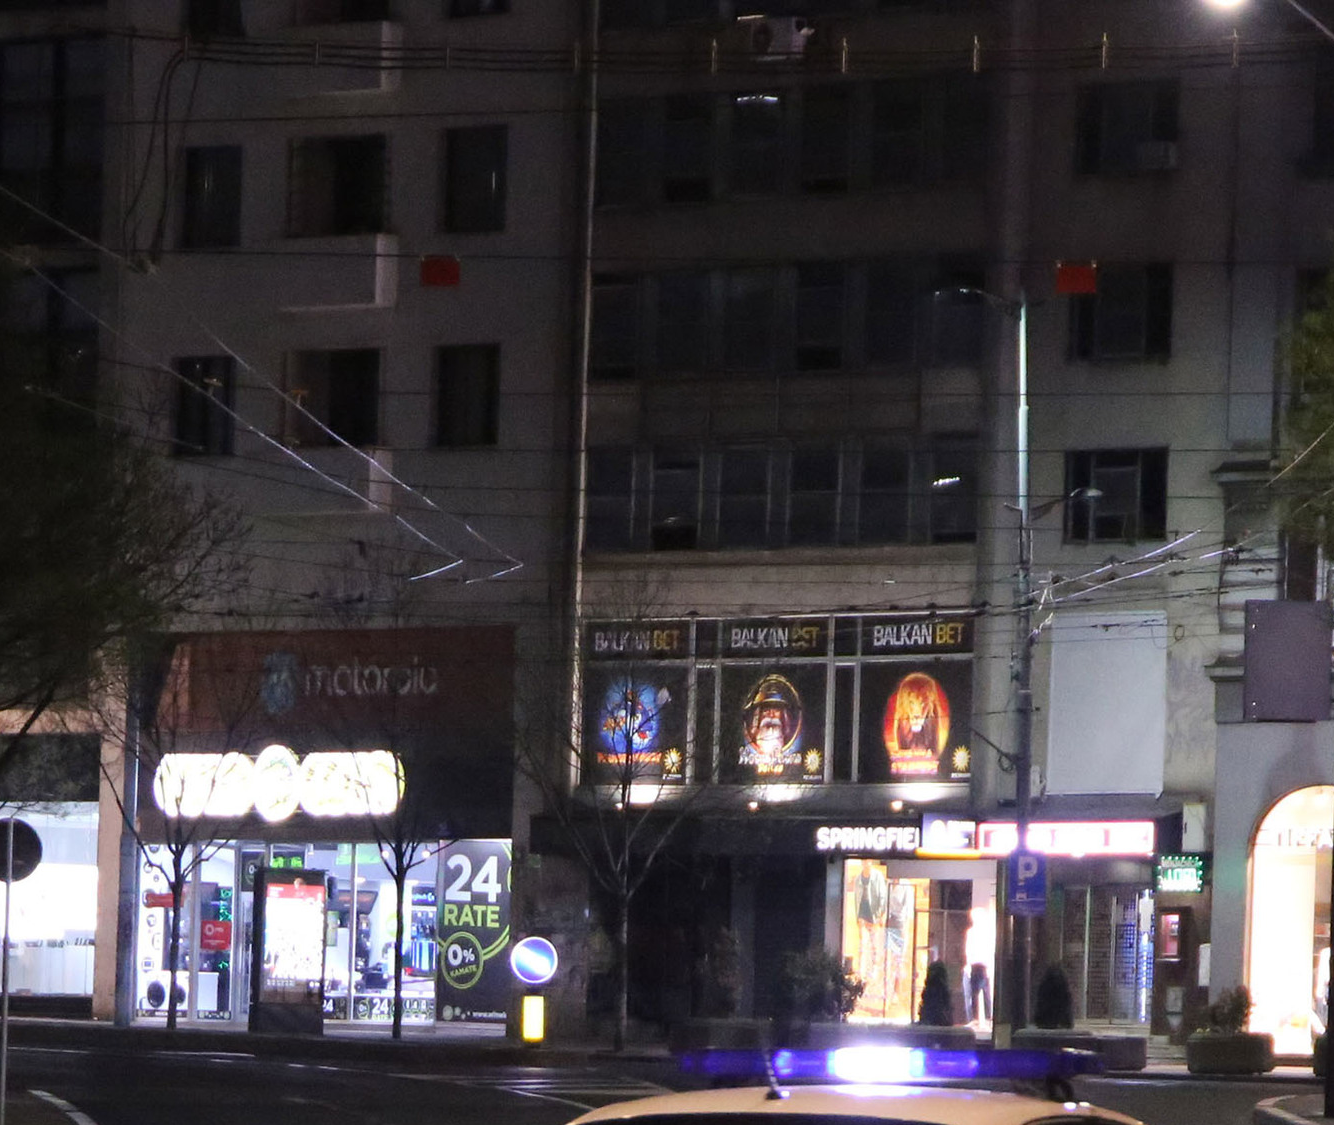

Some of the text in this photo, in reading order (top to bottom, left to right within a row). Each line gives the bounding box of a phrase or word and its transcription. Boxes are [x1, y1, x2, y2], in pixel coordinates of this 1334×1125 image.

[594, 629, 681, 652] BALKAN BET
[730, 626, 789, 649] BALKAN
[872, 621, 965, 646] BALKAN BET
[445, 853, 502, 903] 24
[443, 903, 501, 928] RATE
[447, 943, 476, 966] 0%
[372, 998, 389, 1015] 24
